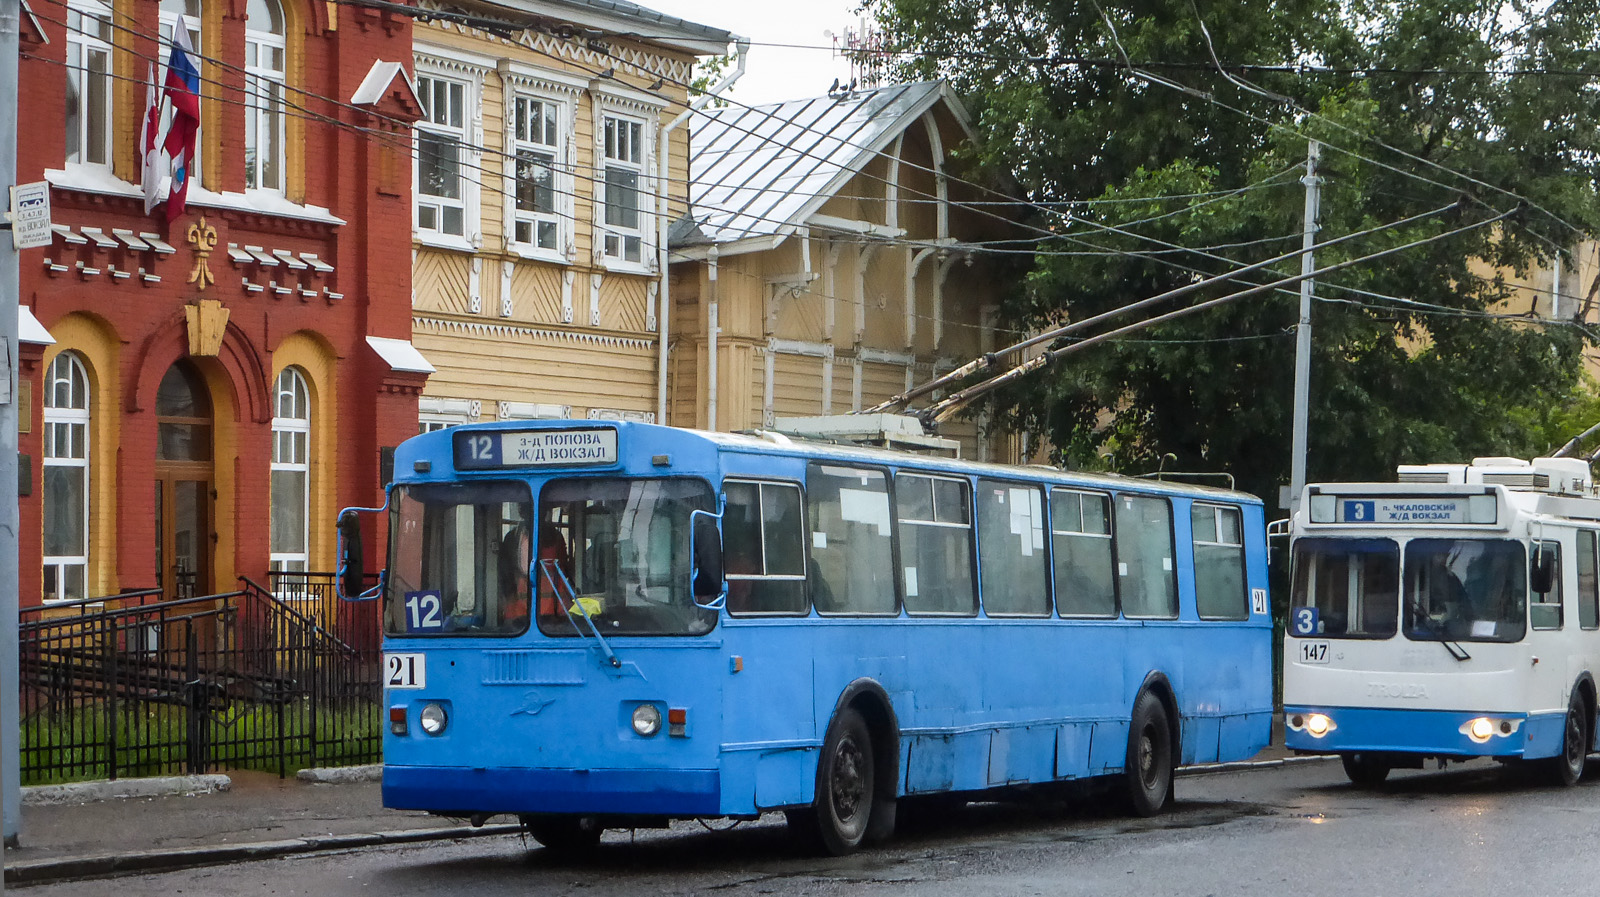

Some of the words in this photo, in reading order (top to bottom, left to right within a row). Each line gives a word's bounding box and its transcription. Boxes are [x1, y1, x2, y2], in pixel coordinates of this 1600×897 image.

[468, 435, 493, 460] 12
[545, 434, 601, 446] ПОПОВА
[517, 448, 546, 461] Ж/Д
[550, 447, 606, 459] ВОКЗАЛ
[1354, 503, 1365, 520] 3
[1393, 503, 1456, 512] ЧКАЛОВСКИЙ
[1389, 512, 1410, 521] Ж/Д
[1412, 512, 1451, 520] ВОКЗАЛ
[1254, 590, 1266, 613] 21
[406, 594, 442, 629] 12
[1297, 609, 1313, 633] 3
[1303, 644, 1328, 661] 147
[389, 656, 418, 686] 21
[1368, 682, 1429, 700] TROLZA
